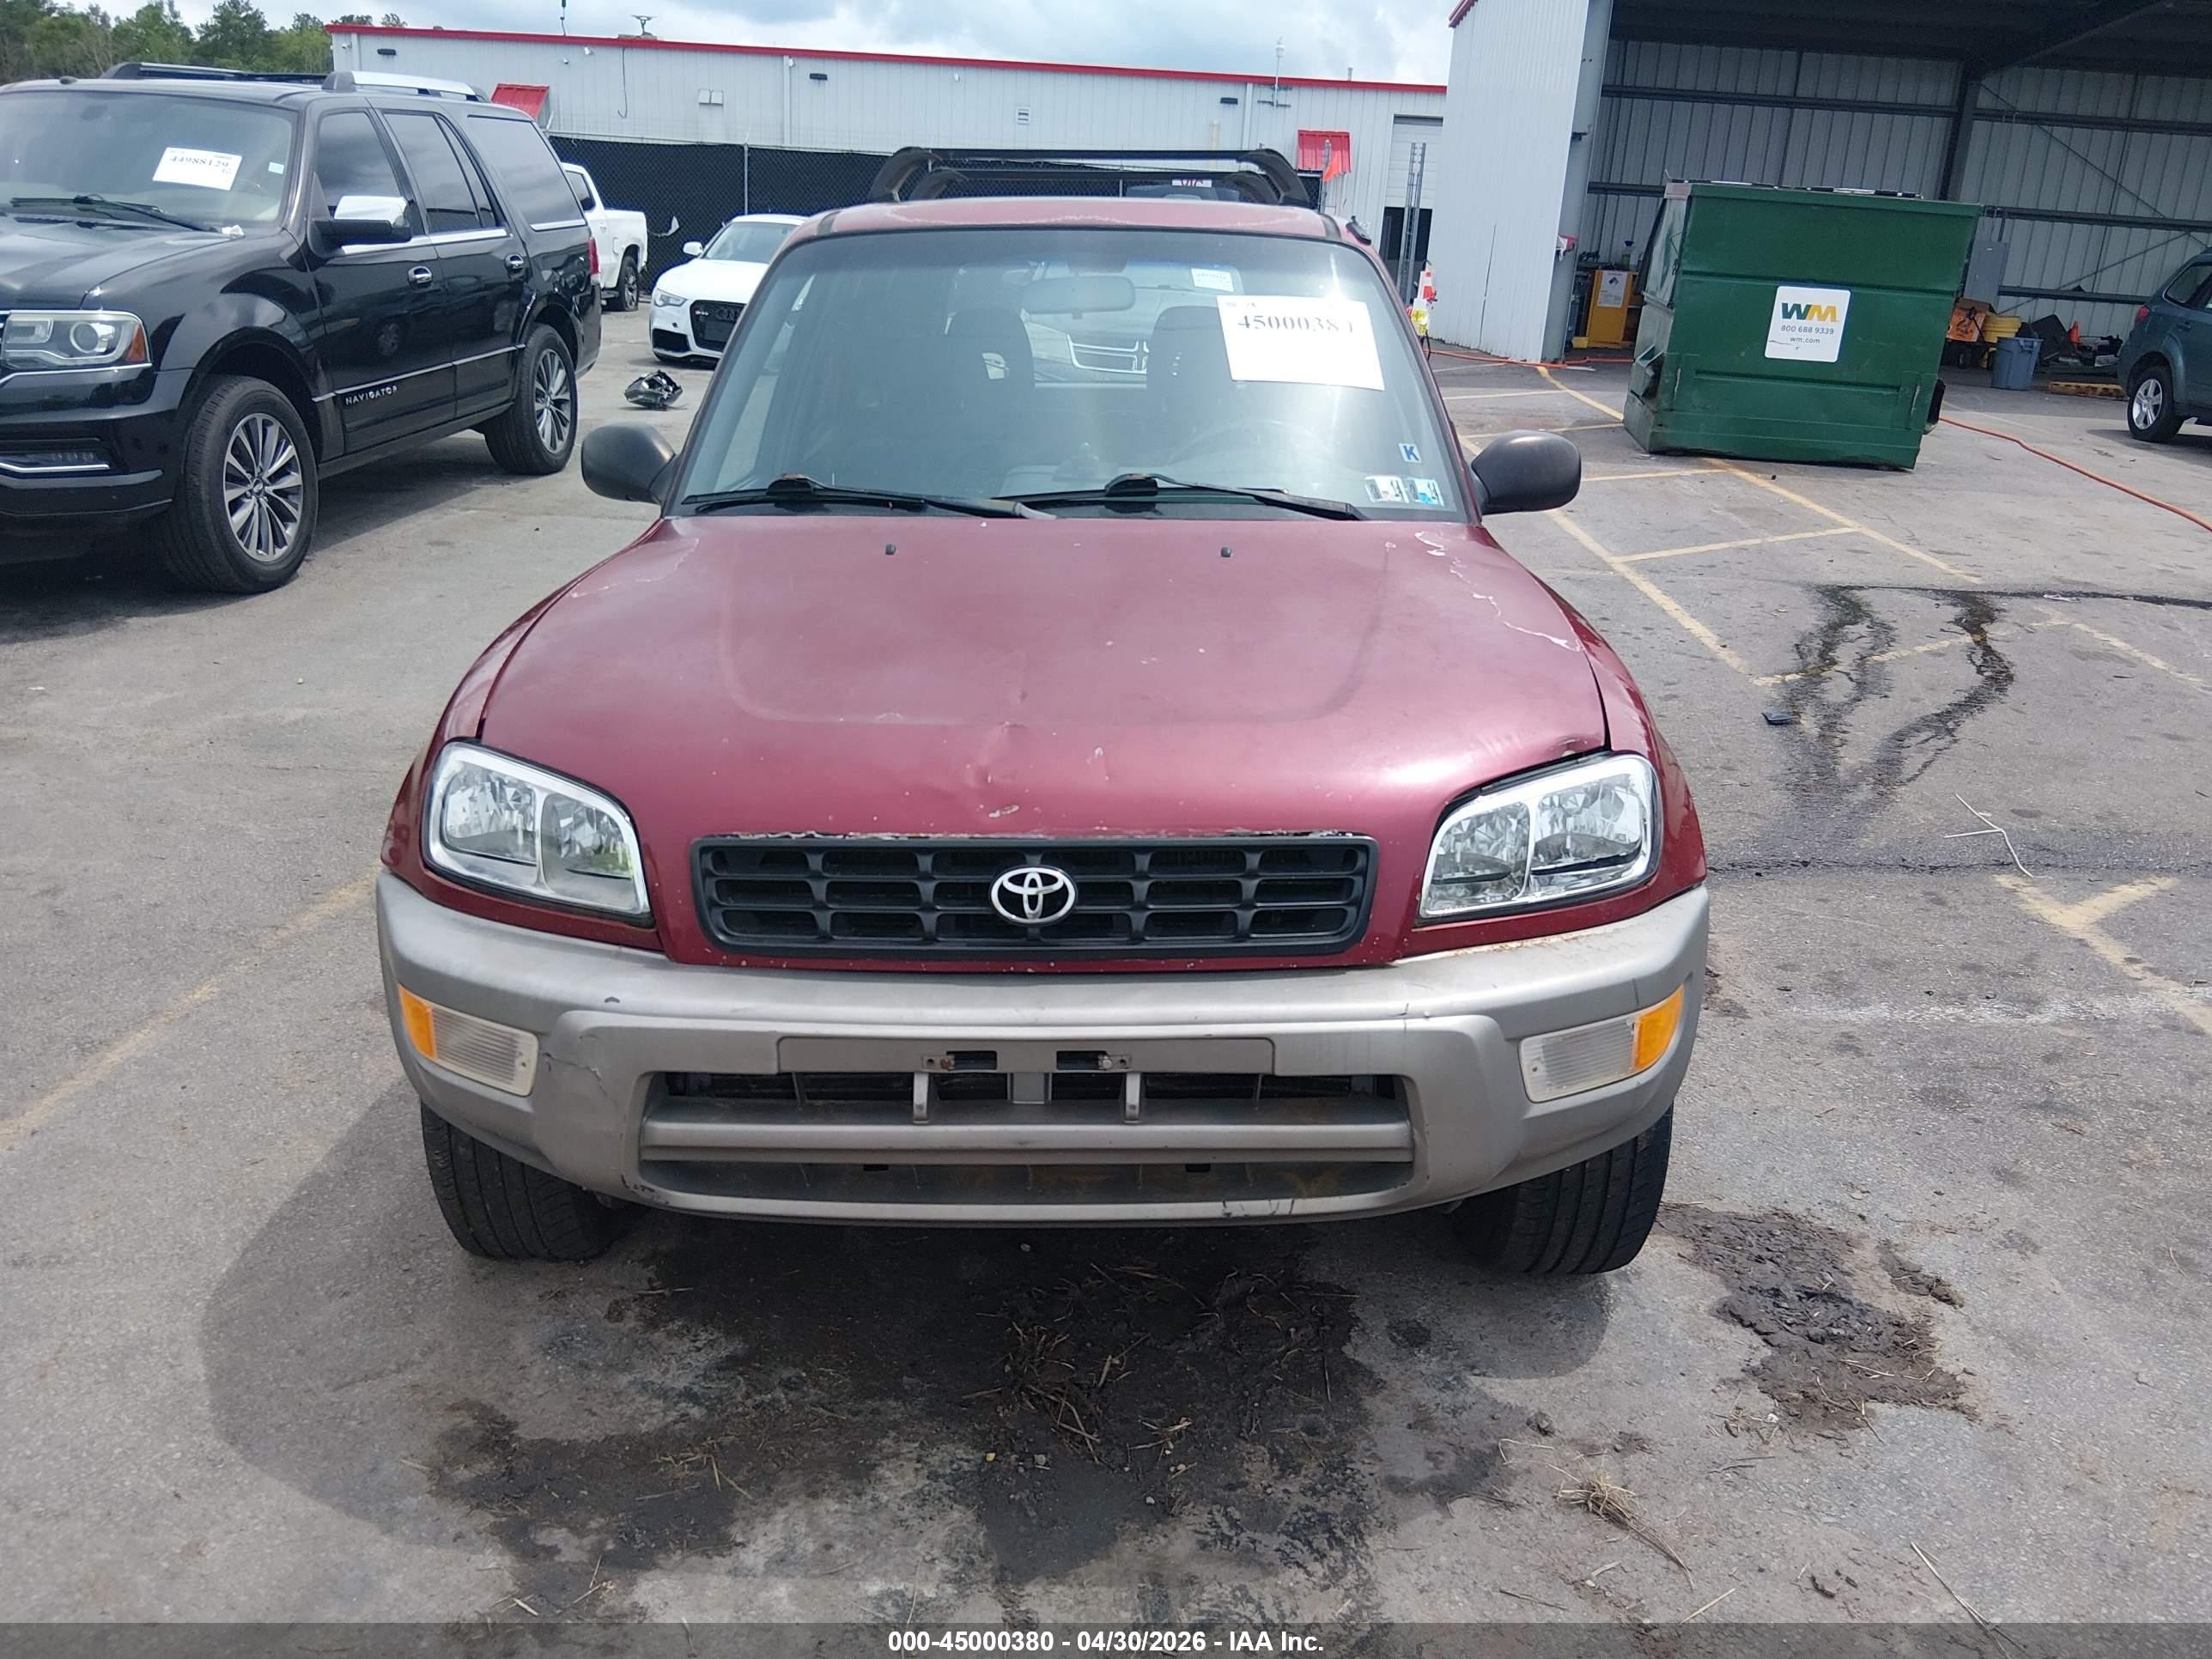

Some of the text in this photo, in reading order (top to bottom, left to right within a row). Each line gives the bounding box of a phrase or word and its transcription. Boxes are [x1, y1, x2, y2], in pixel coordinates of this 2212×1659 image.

[1781, 302, 1838, 322] WM
[1797, 325, 1813, 334] 688
[1814, 326, 1834, 335] 9339
[345, 385, 398, 405] NAVIGATOR
[1402, 445, 1419, 460] K
